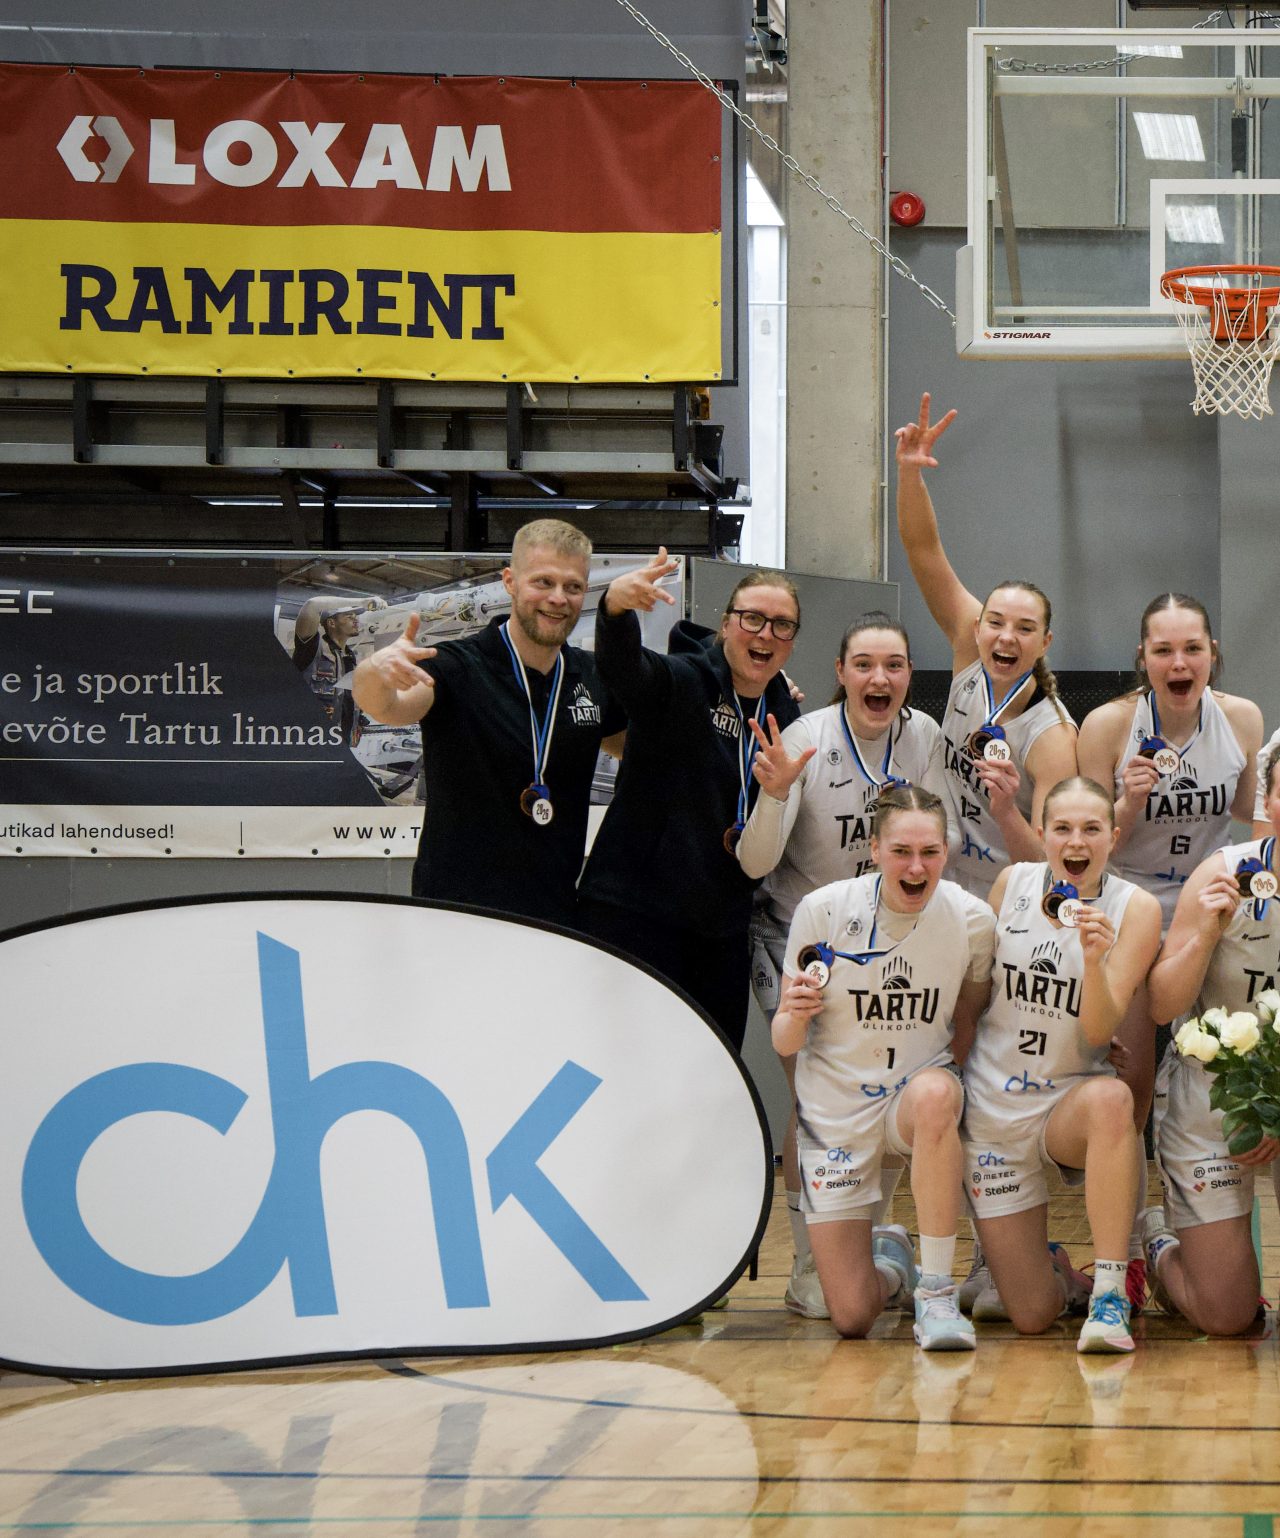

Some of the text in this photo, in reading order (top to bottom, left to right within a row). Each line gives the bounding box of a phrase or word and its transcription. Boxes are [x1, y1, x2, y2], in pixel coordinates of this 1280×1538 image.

[148, 118, 512, 192] LOXAM
[59, 263, 516, 341] RAMIRENT
[32, 664, 66, 702] ja
[77, 662, 223, 703] sportlik
[2, 712, 343, 746] evõte Tartu linnas
[961, 795, 981, 824] 12
[1145, 784, 1226, 821] TARTU
[61, 822, 175, 840] lahendused!
[848, 988, 940, 1024] TARTU
[1002, 963, 1083, 1018] TARTU
[887, 1047, 896, 1070] 1
[1018, 1029, 1047, 1056] 21
[21, 930, 650, 1326] chk
[826, 1178, 861, 1190] Stebby
[985, 1183, 1021, 1197] Stebby
